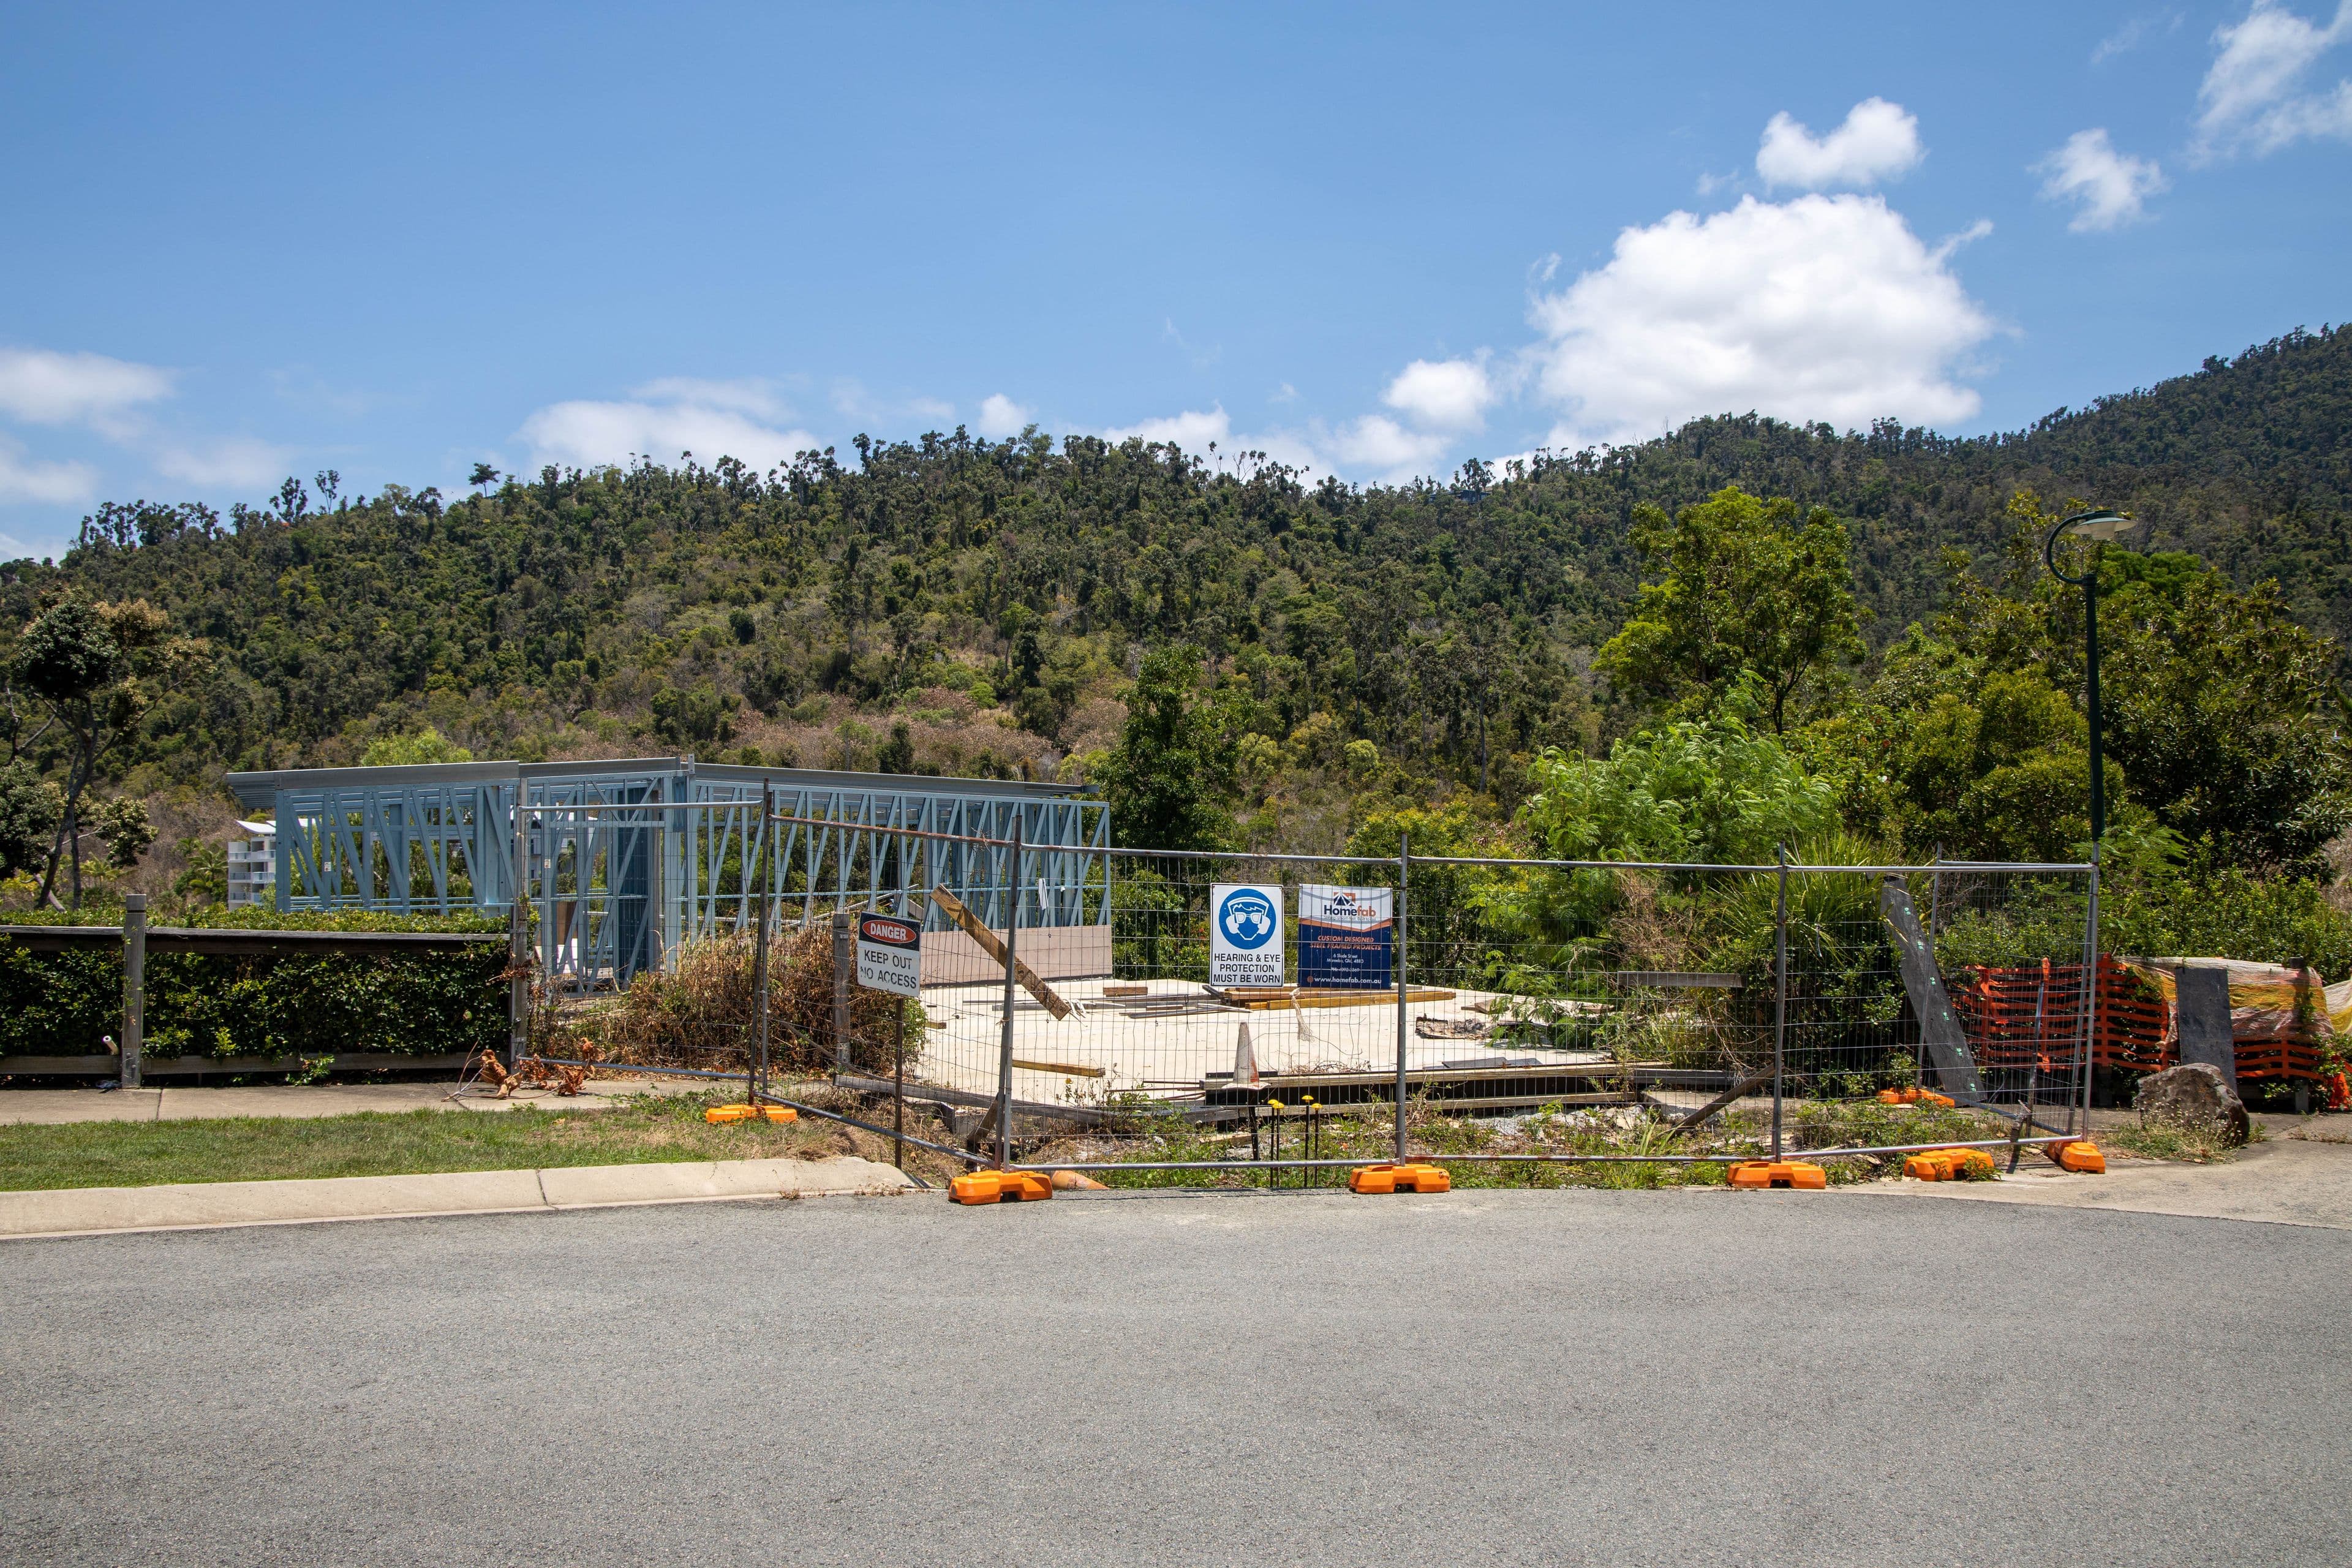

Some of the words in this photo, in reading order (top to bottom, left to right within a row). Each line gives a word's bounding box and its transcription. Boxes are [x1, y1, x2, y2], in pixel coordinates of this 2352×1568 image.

[1324, 905, 1376, 916] Homefab
[870, 922, 907, 940] DANGER
[864, 949, 889, 964] KEEP
[892, 955, 912, 970] OUT
[1214, 953, 1253, 962] HEARING
[1256, 954, 1261, 962] &
[1219, 963, 1275, 973] PROTECTION
[860, 966, 873, 979] NO
[878, 970, 916, 989] ACCESS
[1213, 974, 1237, 982] MUST
